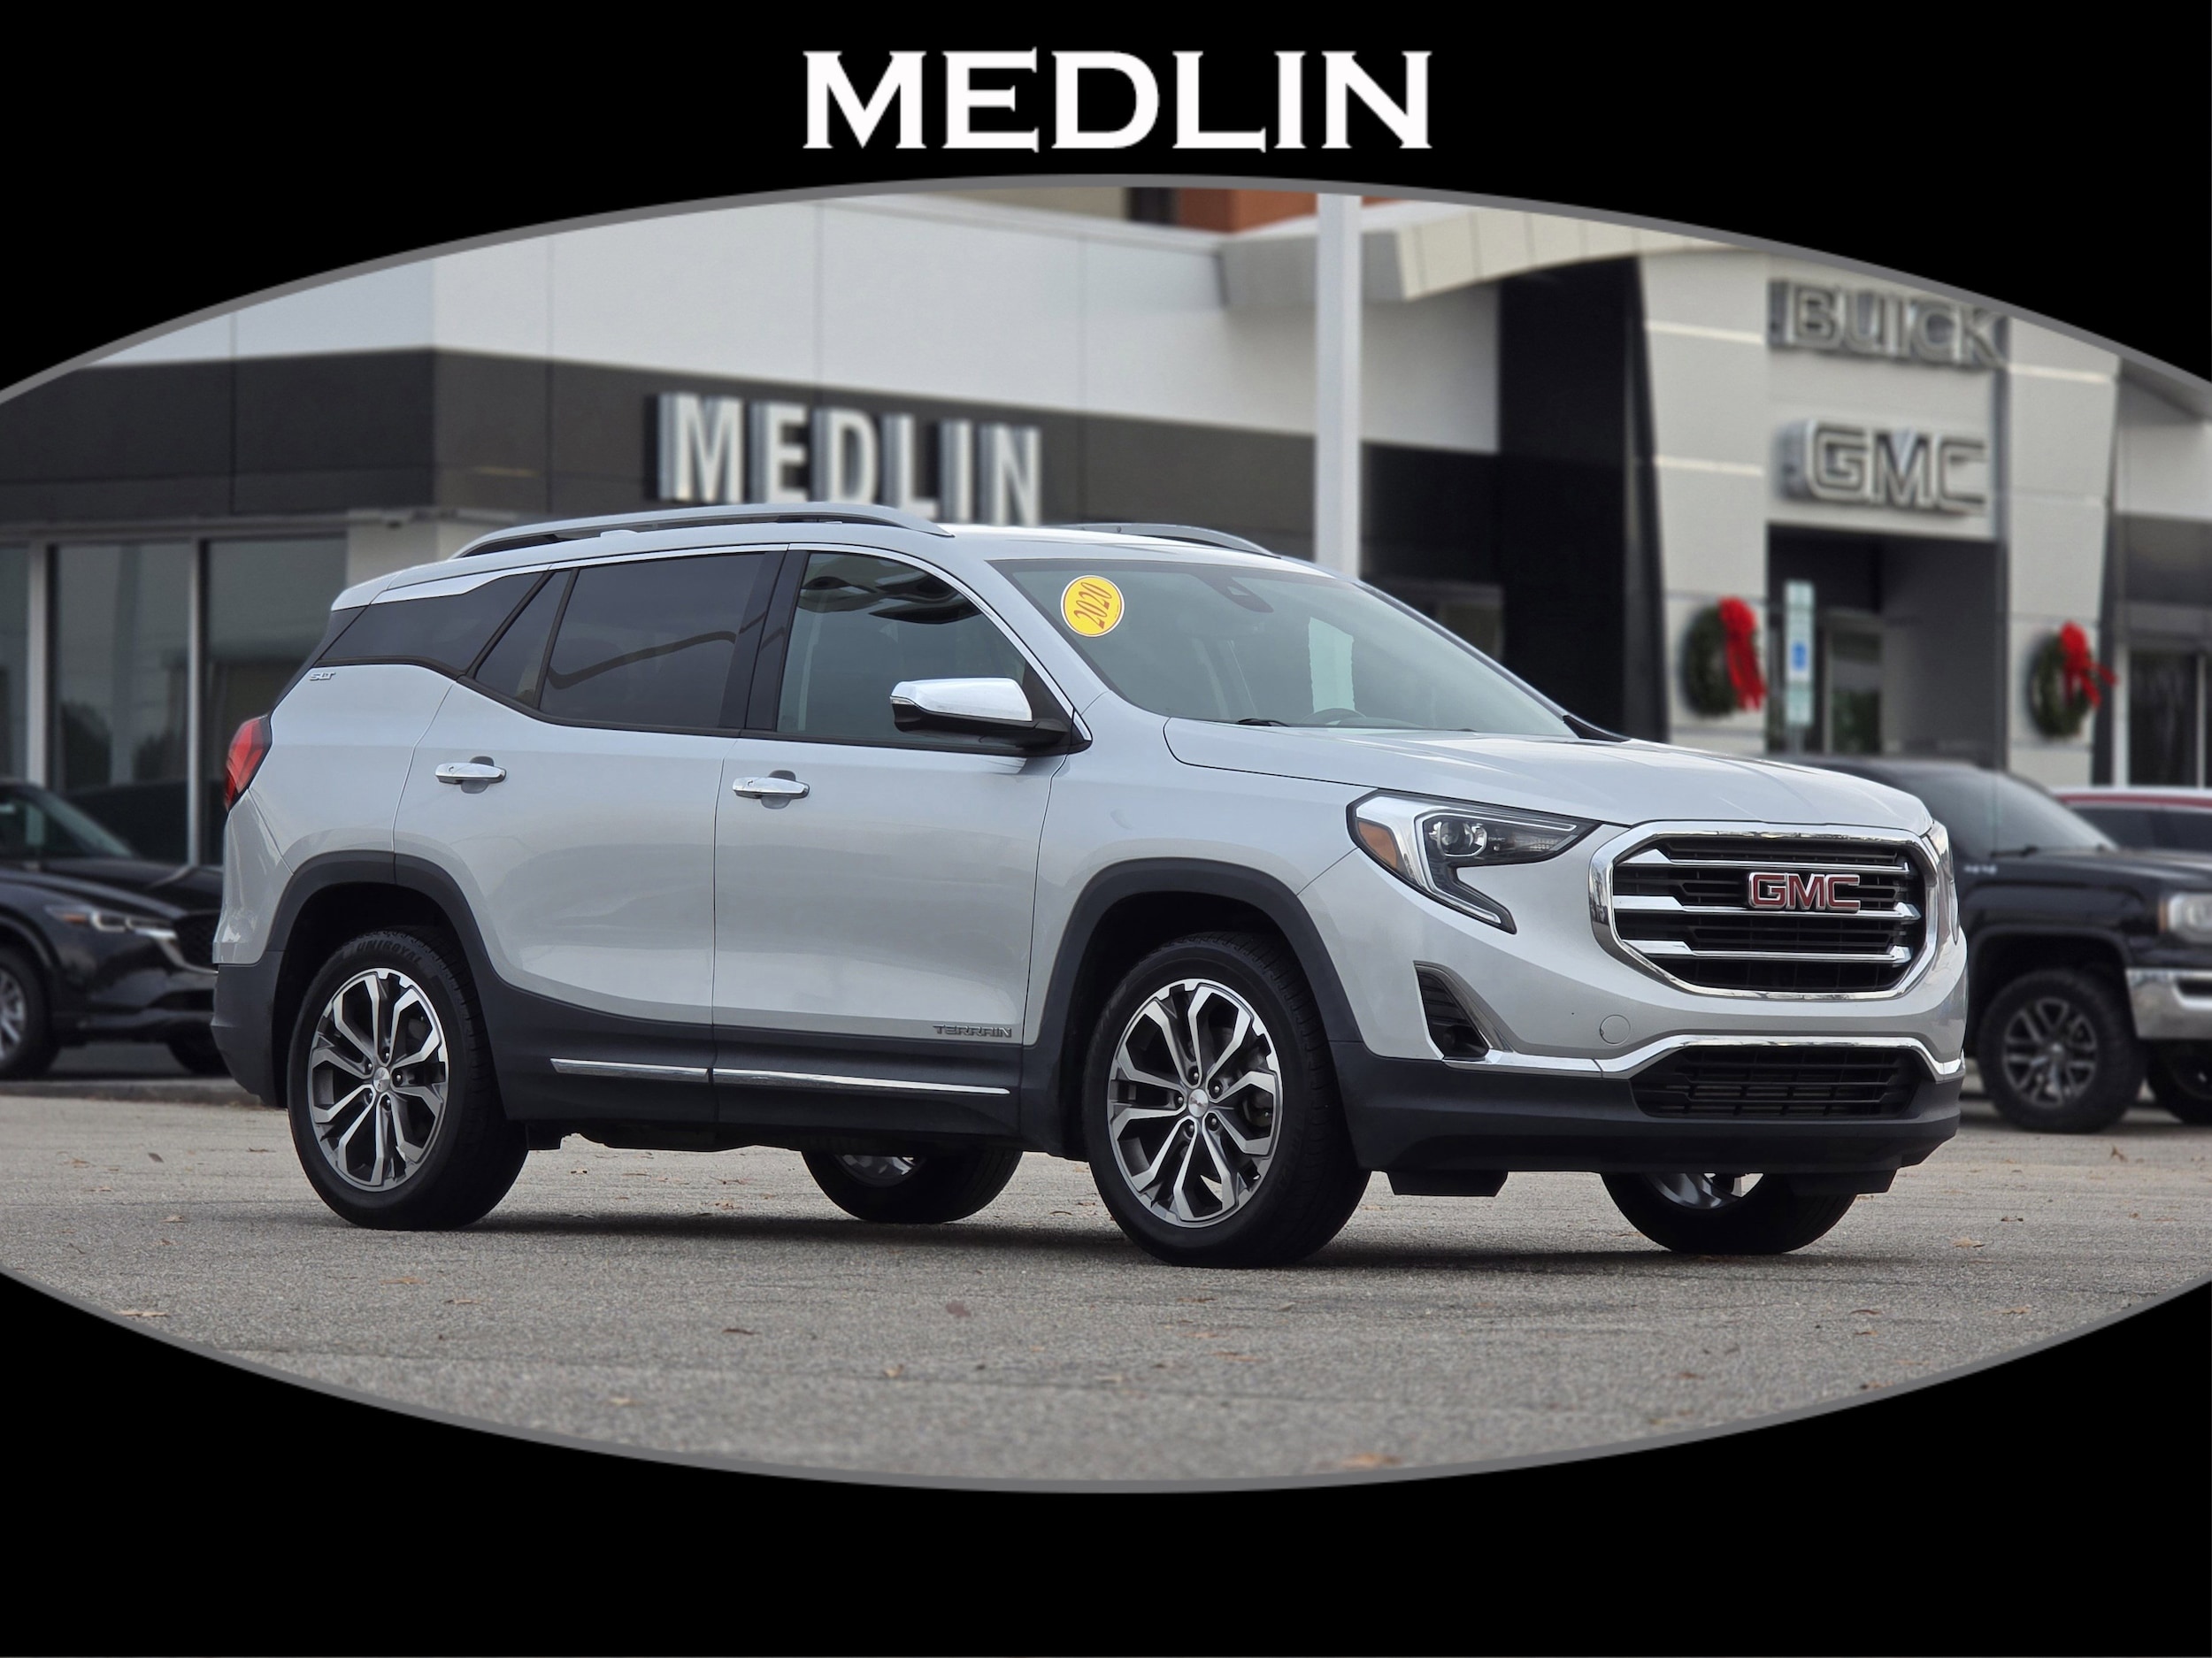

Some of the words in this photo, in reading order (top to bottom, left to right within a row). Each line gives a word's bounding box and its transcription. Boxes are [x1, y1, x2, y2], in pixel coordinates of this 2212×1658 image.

[1771, 282, 2006, 369] BUICK
[659, 392, 1041, 526] MEDLIN
[1780, 420, 1988, 515] GMC
[1073, 582, 1112, 629] 2020
[308, 672, 336, 682] SLT
[1747, 871, 1861, 912] GMC
[357, 940, 422, 963] UNIROYAL
[932, 1024, 1012, 1038] TERRAIN
